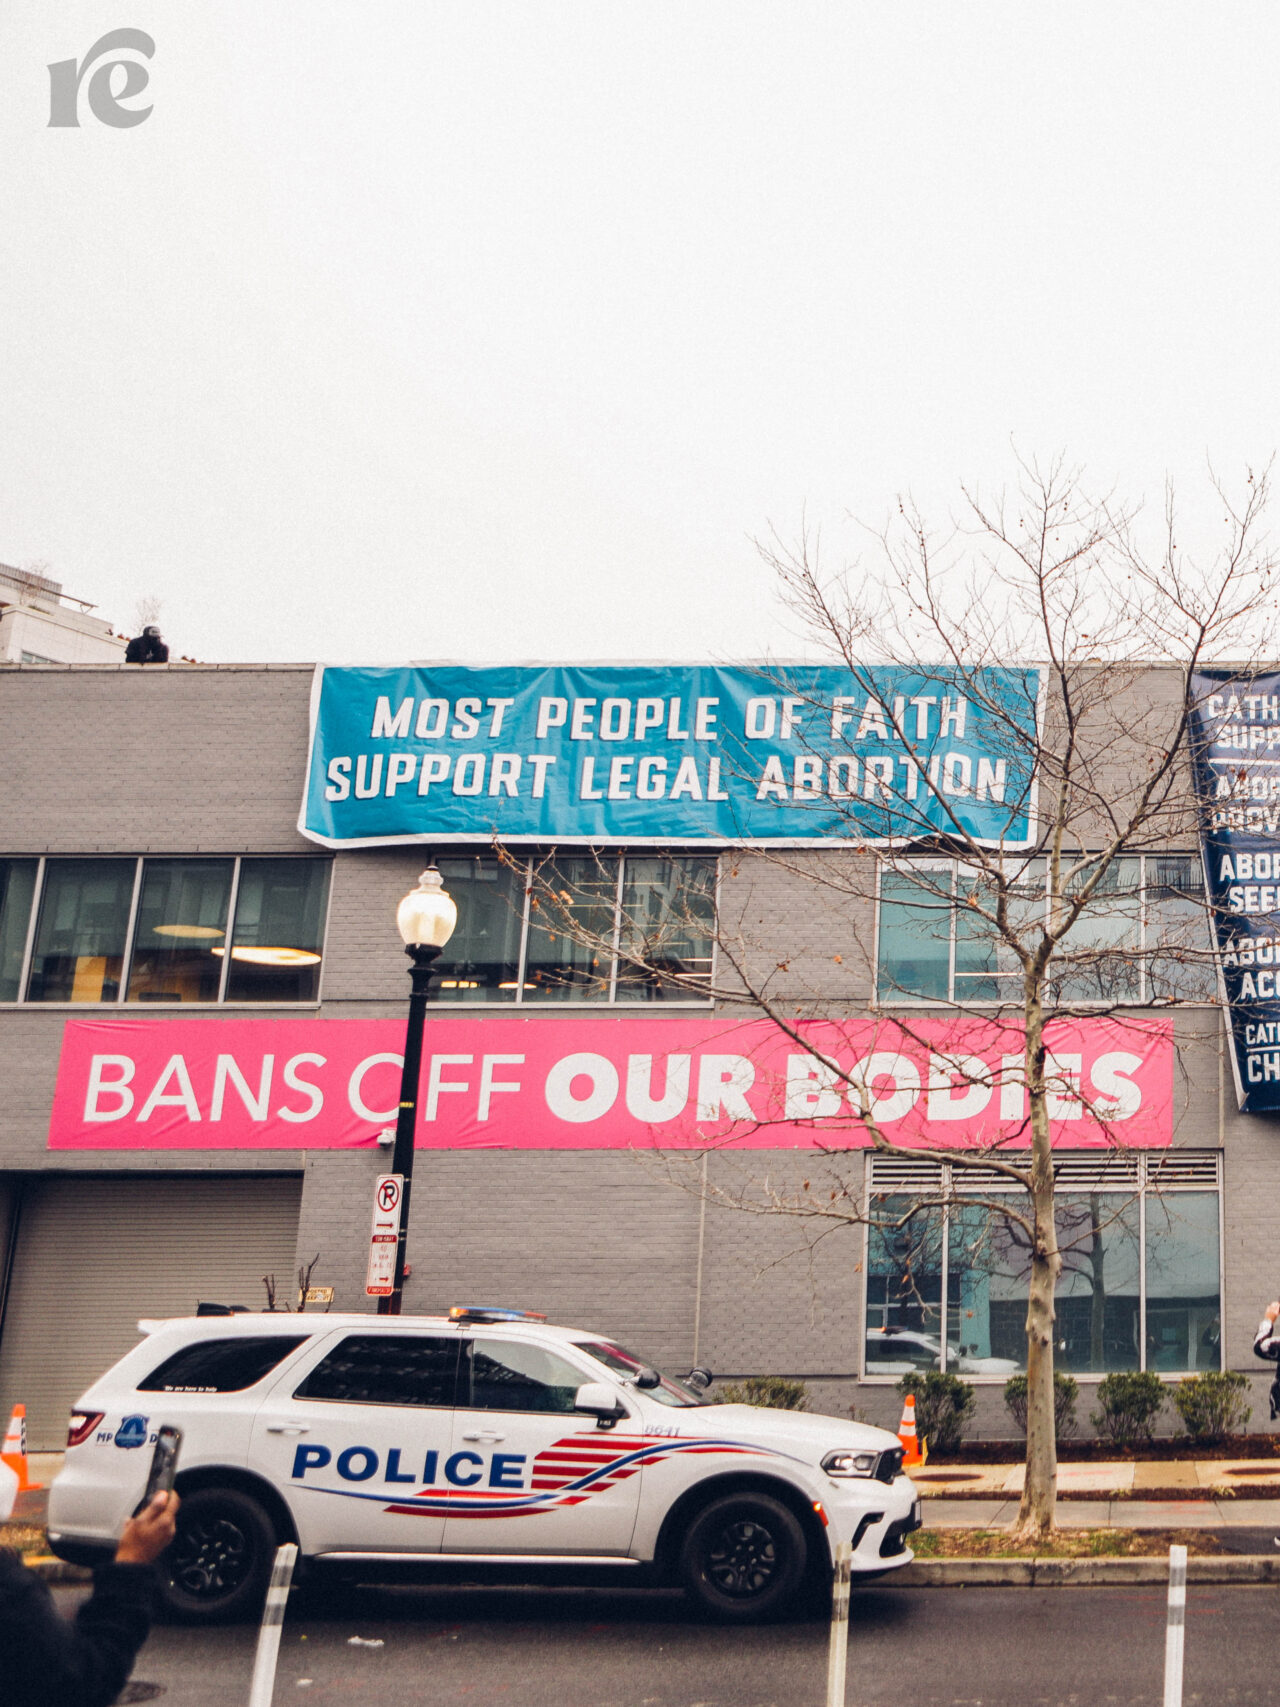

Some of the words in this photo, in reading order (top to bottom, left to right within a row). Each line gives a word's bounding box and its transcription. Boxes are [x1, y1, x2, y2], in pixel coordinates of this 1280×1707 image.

[371, 696, 514, 739] MOST
[536, 697, 720, 740] PEOPLE
[745, 697, 805, 740] OF
[831, 696, 967, 740] FAITH
[325, 753, 557, 802] SUPPORT
[580, 756, 730, 801] LEGAL
[756, 752, 1006, 802] ABORTION
[83, 1053, 327, 1122] BANS
[348, 1053, 526, 1122] OFF
[544, 1051, 757, 1123] OUR
[784, 1051, 1145, 1122] BODIES
[291, 1443, 528, 1489] POLICE
